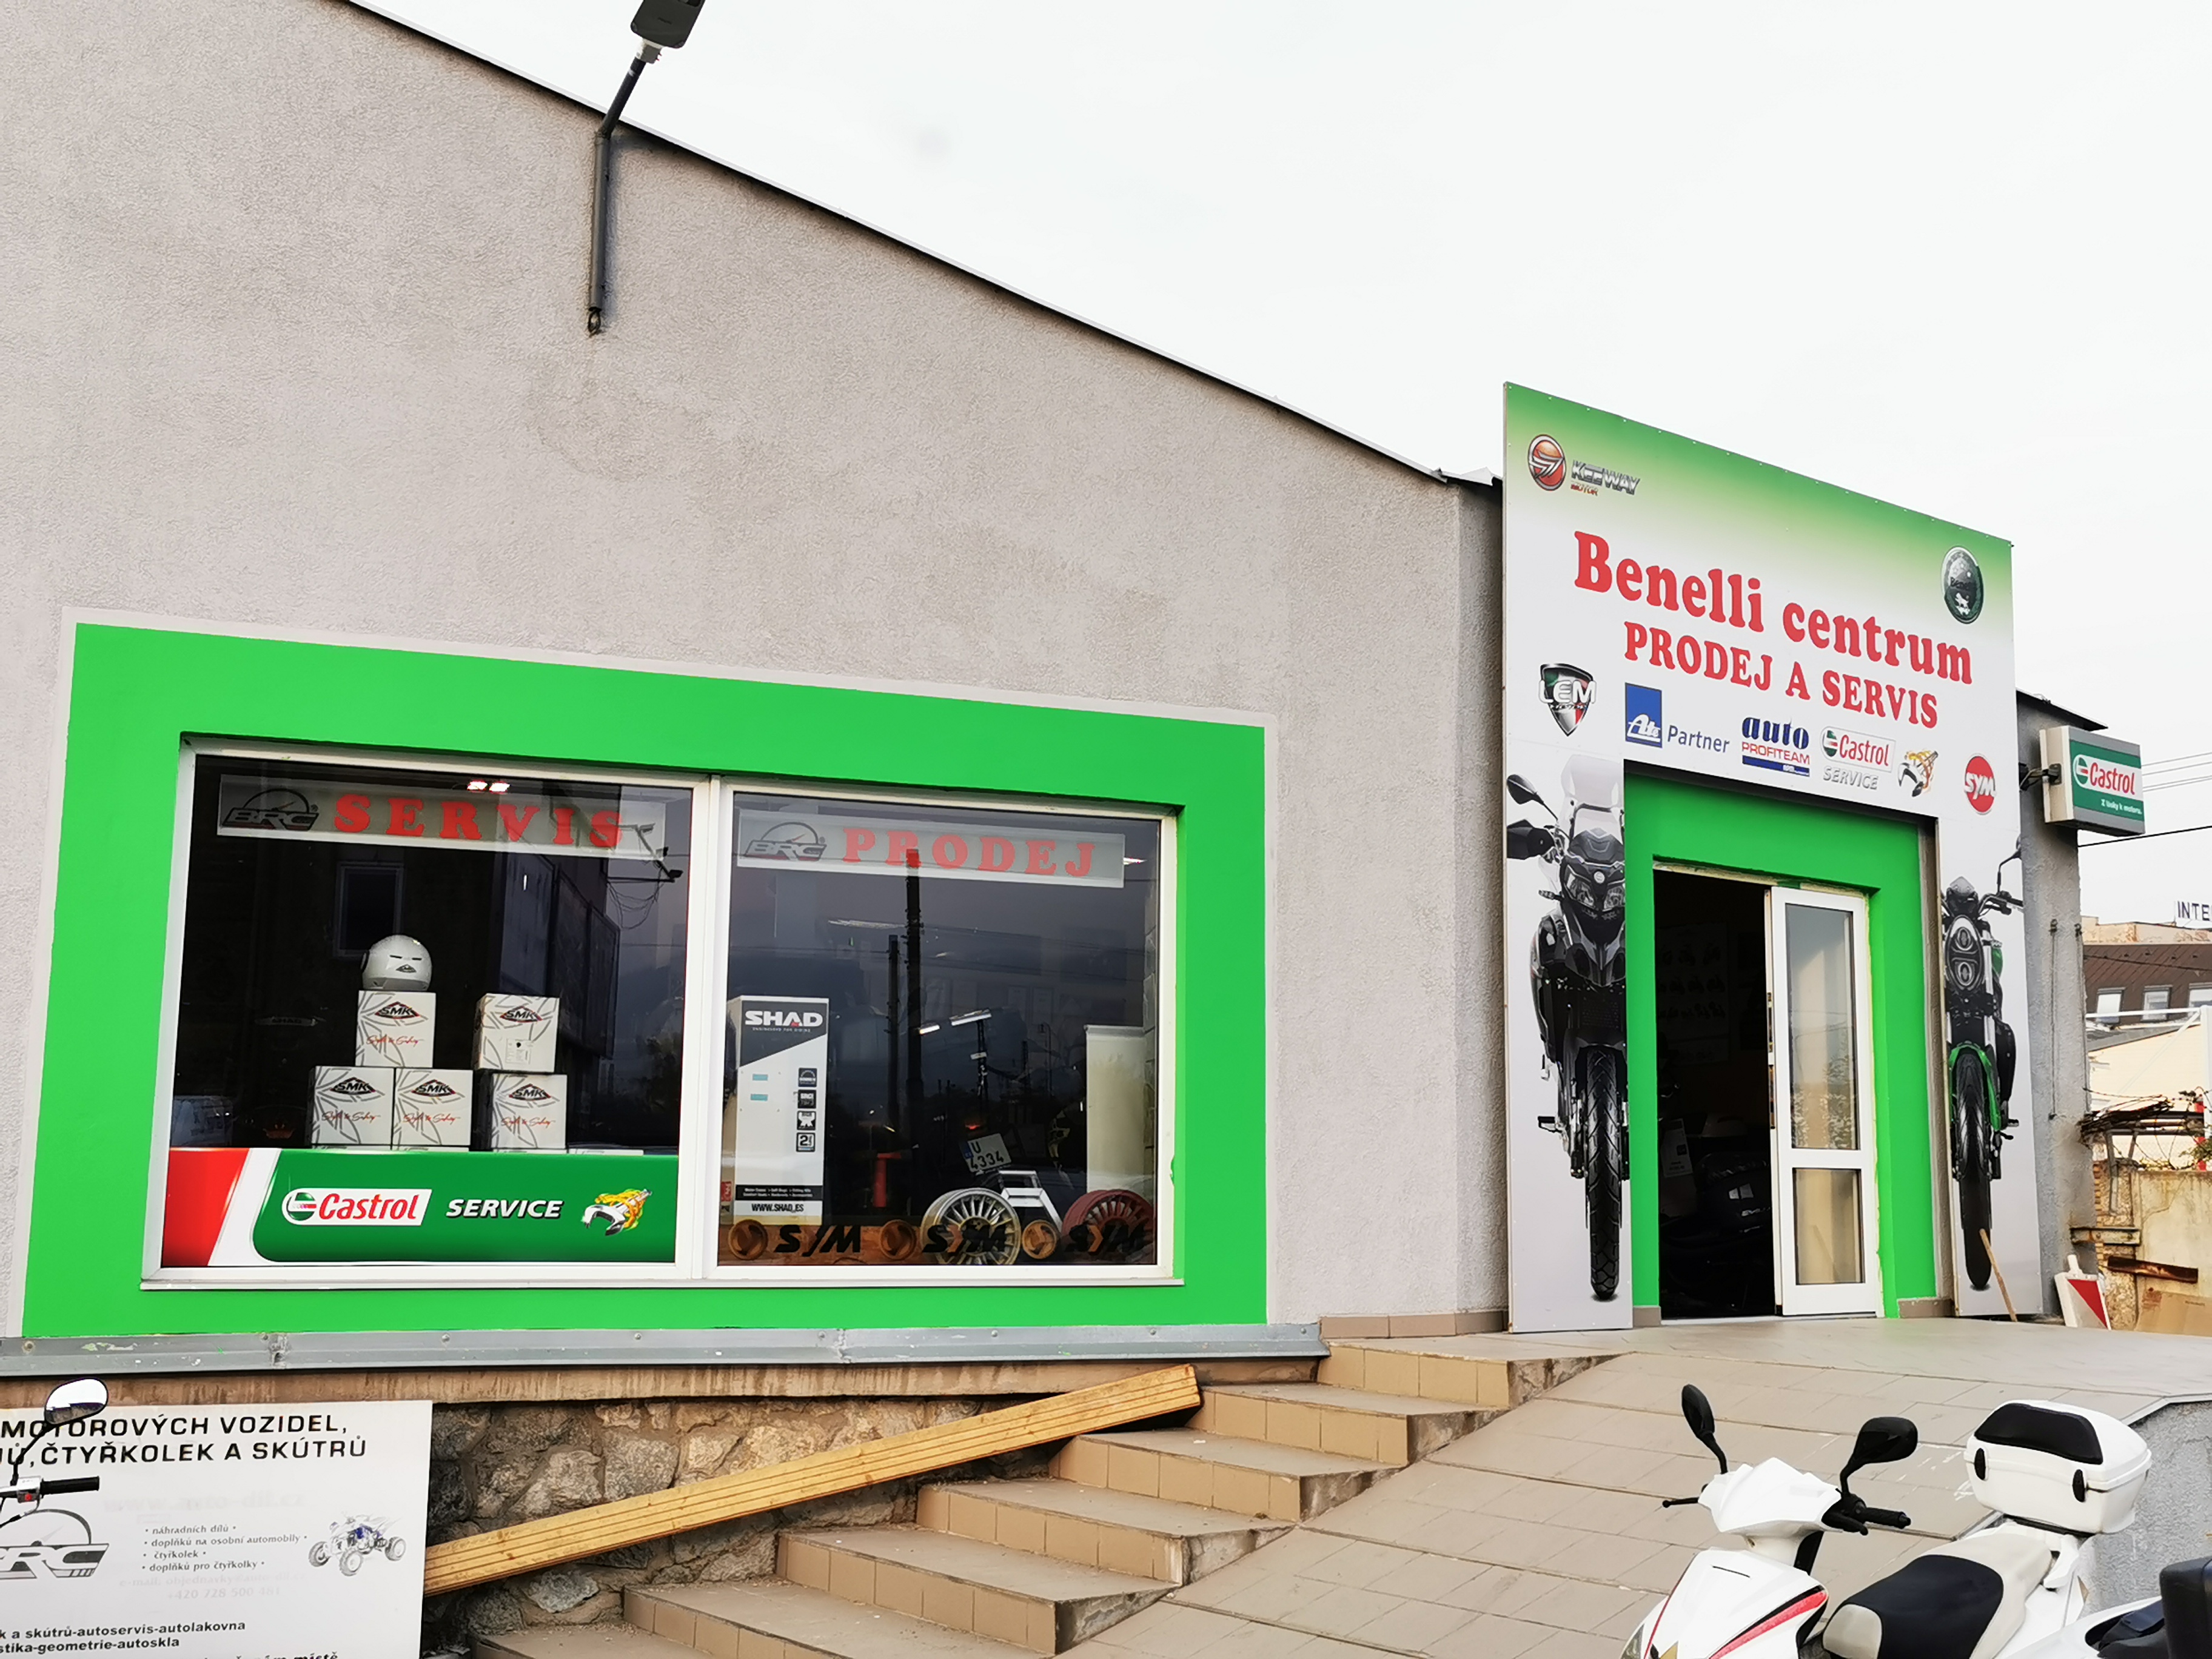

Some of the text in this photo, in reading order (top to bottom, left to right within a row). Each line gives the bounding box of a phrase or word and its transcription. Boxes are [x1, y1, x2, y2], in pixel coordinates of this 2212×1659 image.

[1574, 531, 1973, 685] Benelli centrum
[1624, 622, 1938, 728] PRODEJ A SERVIS
[1538, 679, 1597, 705] LEM
[1667, 725, 1730, 753] Partner
[1742, 716, 1809, 749] auto
[1741, 741, 1811, 765] PROFITEAM
[1839, 734, 1889, 767] Castrol
[1823, 765, 1879, 791] SERVICE
[1963, 771, 1997, 800] SYM
[2090, 762, 2135, 795] Castrol
[333, 794, 623, 848] SERVIS
[843, 828, 1096, 877] PRODEJ
[380, 1007, 413, 1016] SMK
[506, 1010, 538, 1020] SMK
[745, 1010, 823, 1027] SHAD
[337, 1082, 370, 1091] SMK
[419, 1084, 451, 1093] SMK
[515, 1088, 547, 1098] SMK
[970, 1141, 982, 1153] U
[970, 1150, 1004, 1170] 4334
[320, 1193, 565, 1220] Castrol SERVICE
[220, 1415, 347, 1434] VOZIDEL,
[224, 1443, 242, 1461] A
[252, 1435, 366, 1460] SKÚTRŮ
[152, 1524, 207, 1535] náhradních
[210, 1535, 245, 1546] osobní
[193, 1563, 210, 1572] pro
[12, 1631, 21, 1639] a
